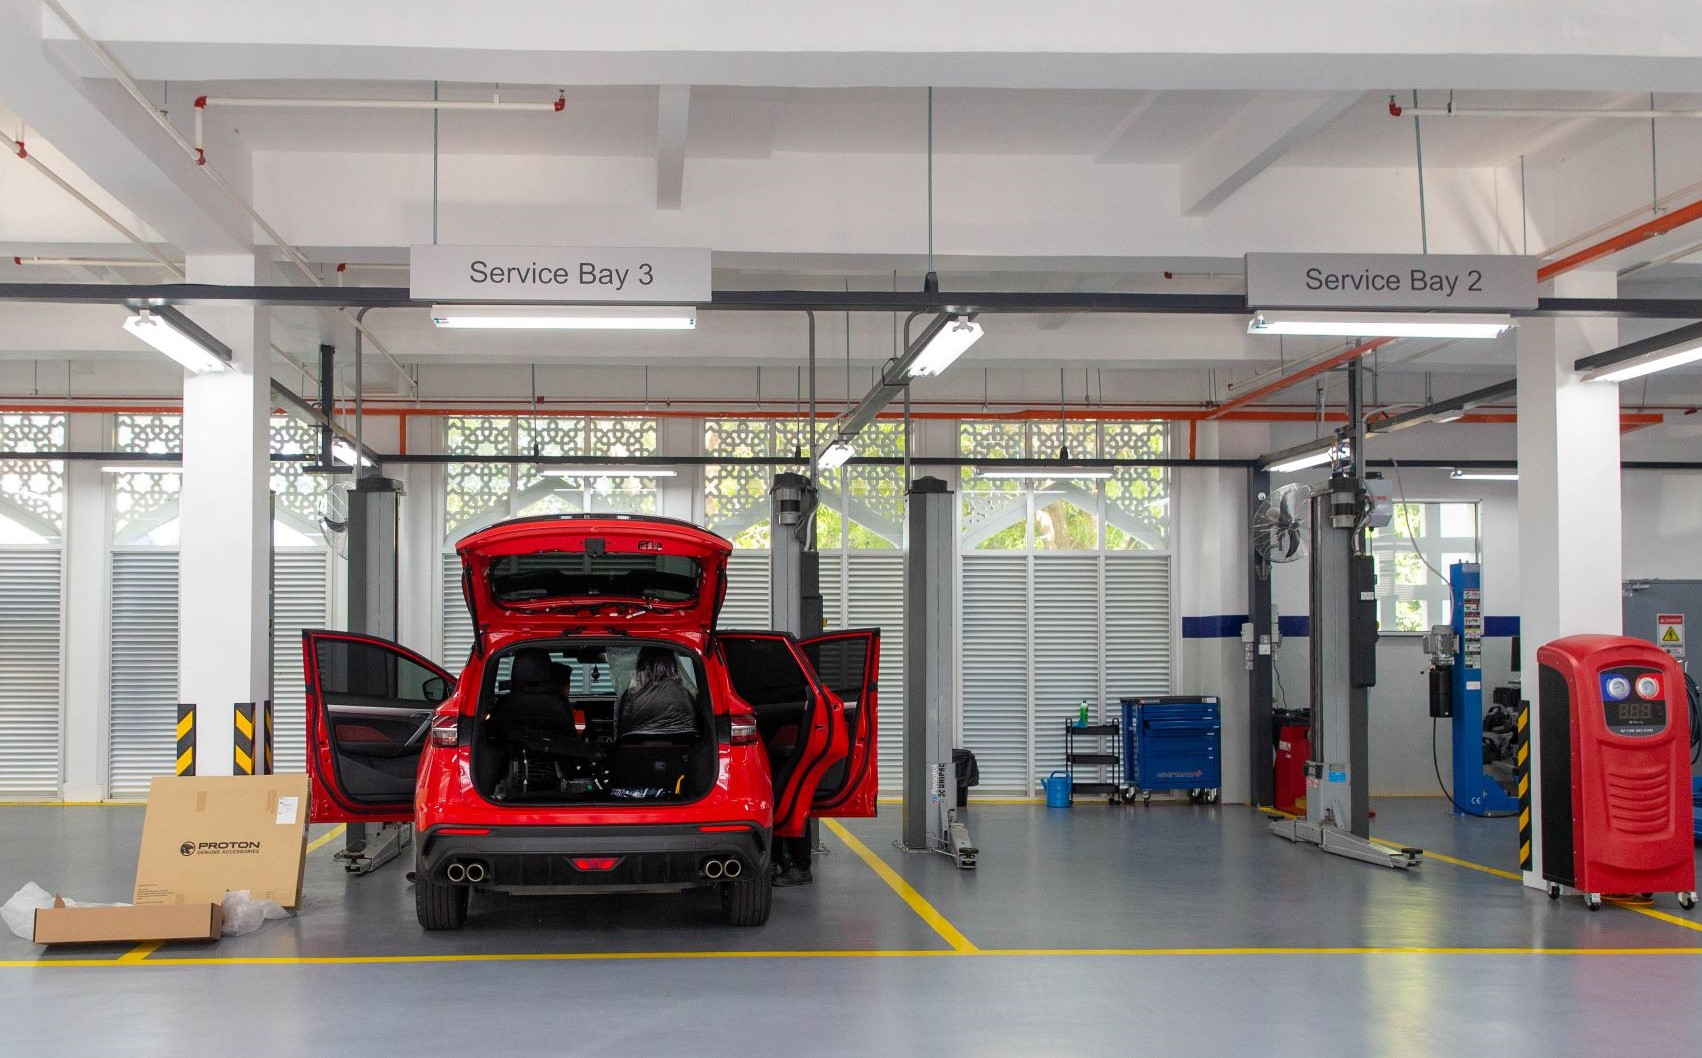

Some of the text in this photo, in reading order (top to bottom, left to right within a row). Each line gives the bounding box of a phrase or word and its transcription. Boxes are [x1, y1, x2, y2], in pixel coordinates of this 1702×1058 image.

[470, 260, 654, 291] Service Bay 3
[1305, 267, 1483, 297] Service Bay 2
[198, 841, 260, 850] PROTON
